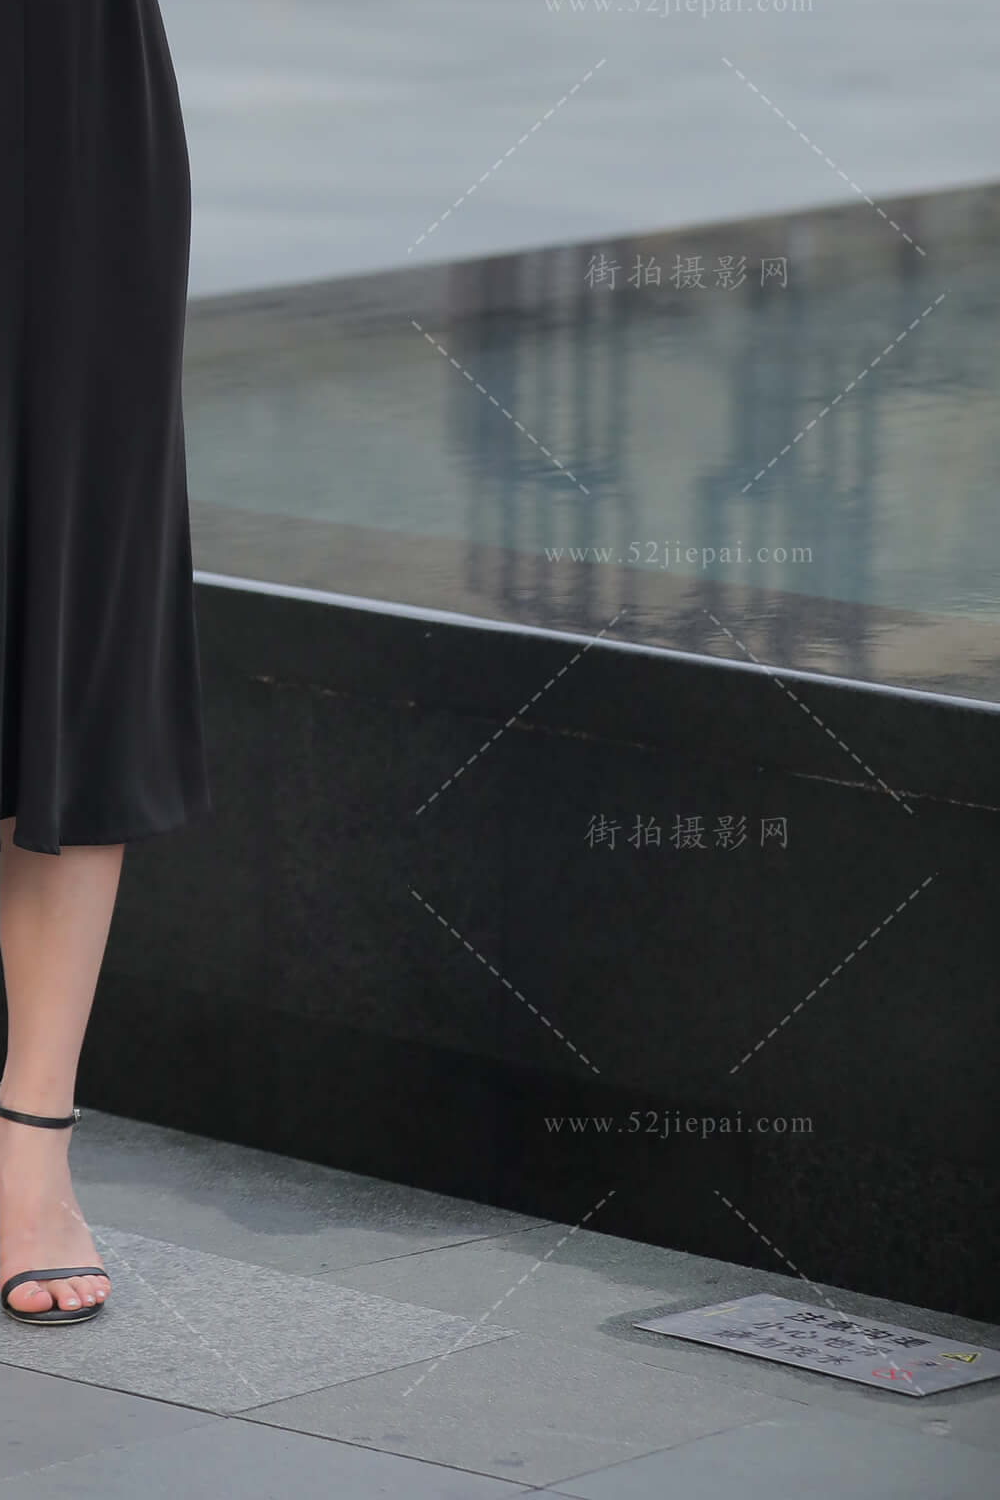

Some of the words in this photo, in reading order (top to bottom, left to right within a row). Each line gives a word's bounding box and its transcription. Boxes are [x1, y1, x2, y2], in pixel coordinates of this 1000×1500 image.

[751, 1321, 893, 1358] 小心地滑
[784, 1311, 931, 1348] 注意沟渠
